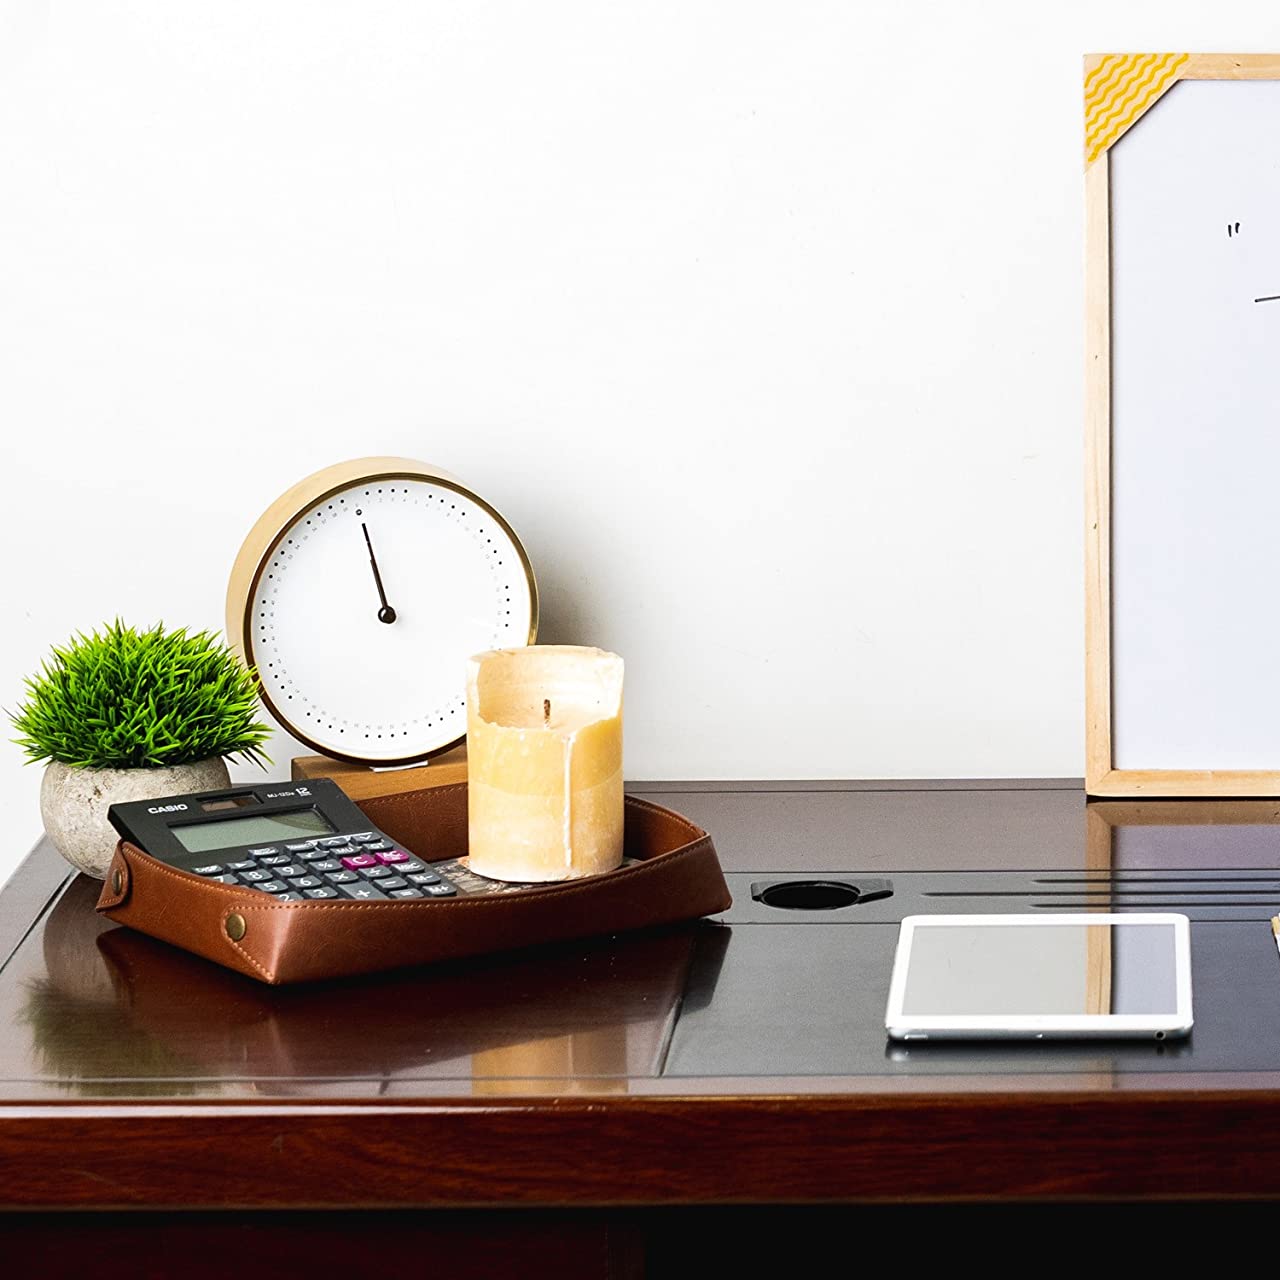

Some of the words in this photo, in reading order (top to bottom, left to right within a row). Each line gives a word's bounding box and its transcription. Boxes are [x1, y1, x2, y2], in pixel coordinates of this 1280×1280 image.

[148, 803, 188, 815] CASIO
[353, 856, 367, 864] C
[249, 871, 262, 879] 8
[282, 866, 294, 875] 9
[263, 881, 277, 890] 5
[300, 877, 311, 886] 6
[313, 888, 328, 897] 3
